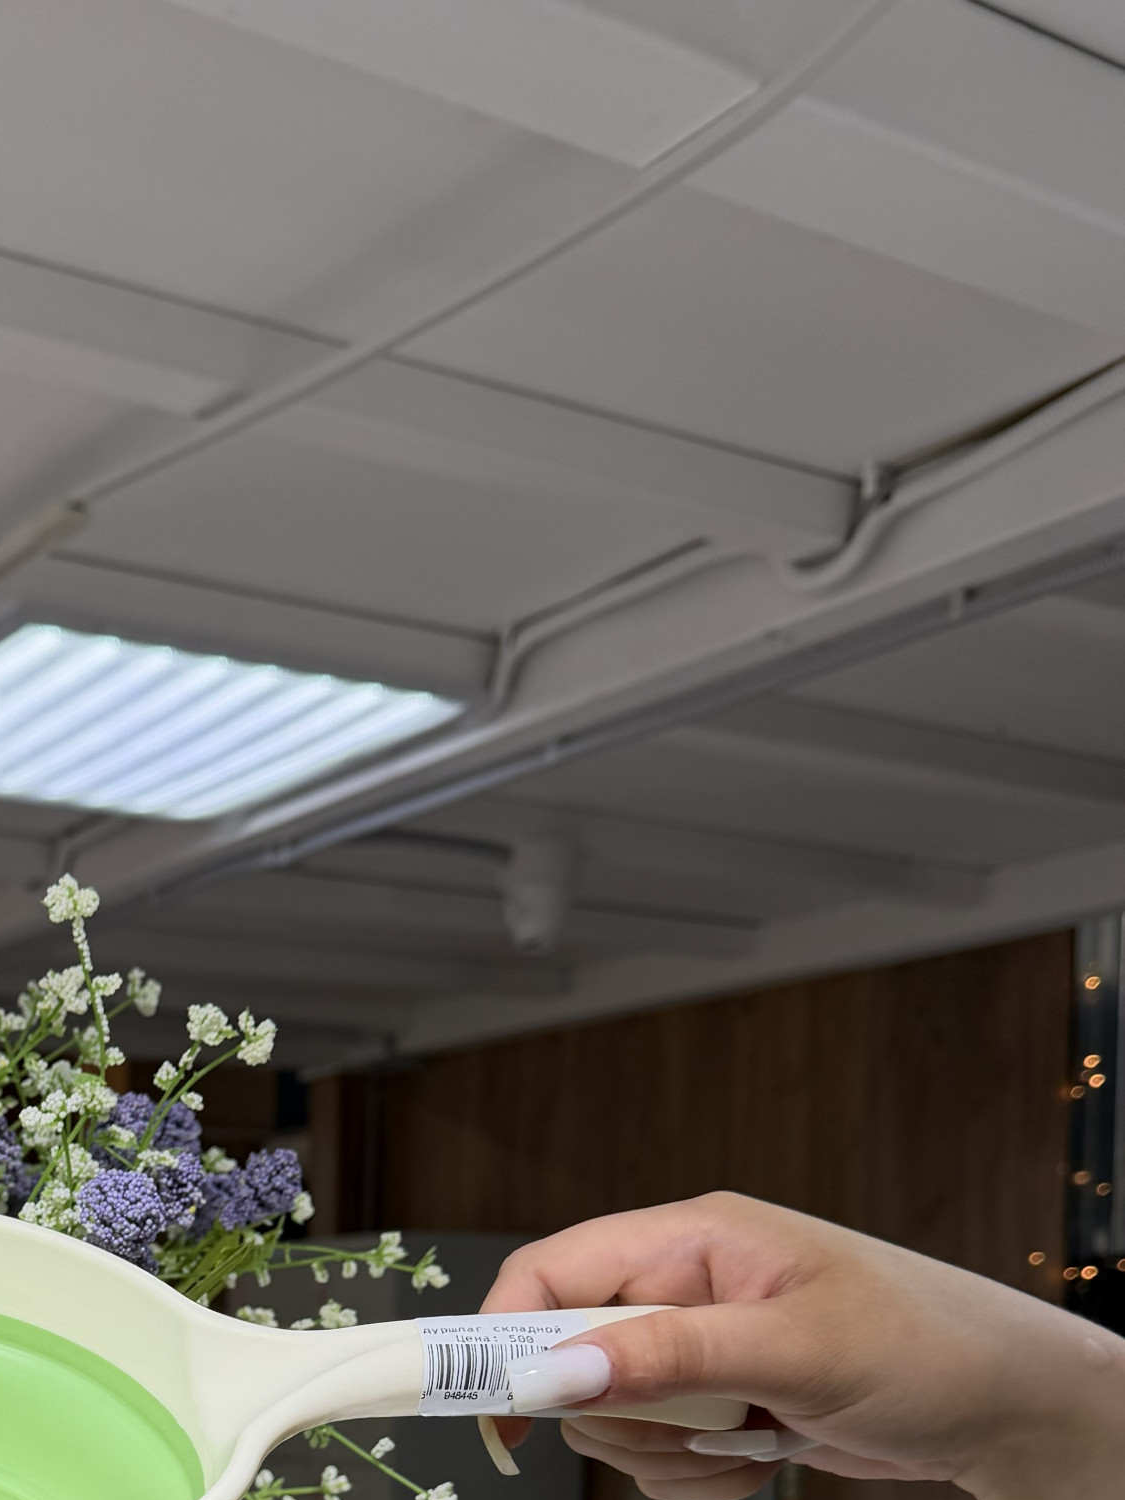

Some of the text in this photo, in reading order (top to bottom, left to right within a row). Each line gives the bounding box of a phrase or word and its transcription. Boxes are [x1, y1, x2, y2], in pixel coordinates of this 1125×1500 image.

[493, 1325, 562, 1334] складной
[455, 1334, 534, 1343] Цена: 500
